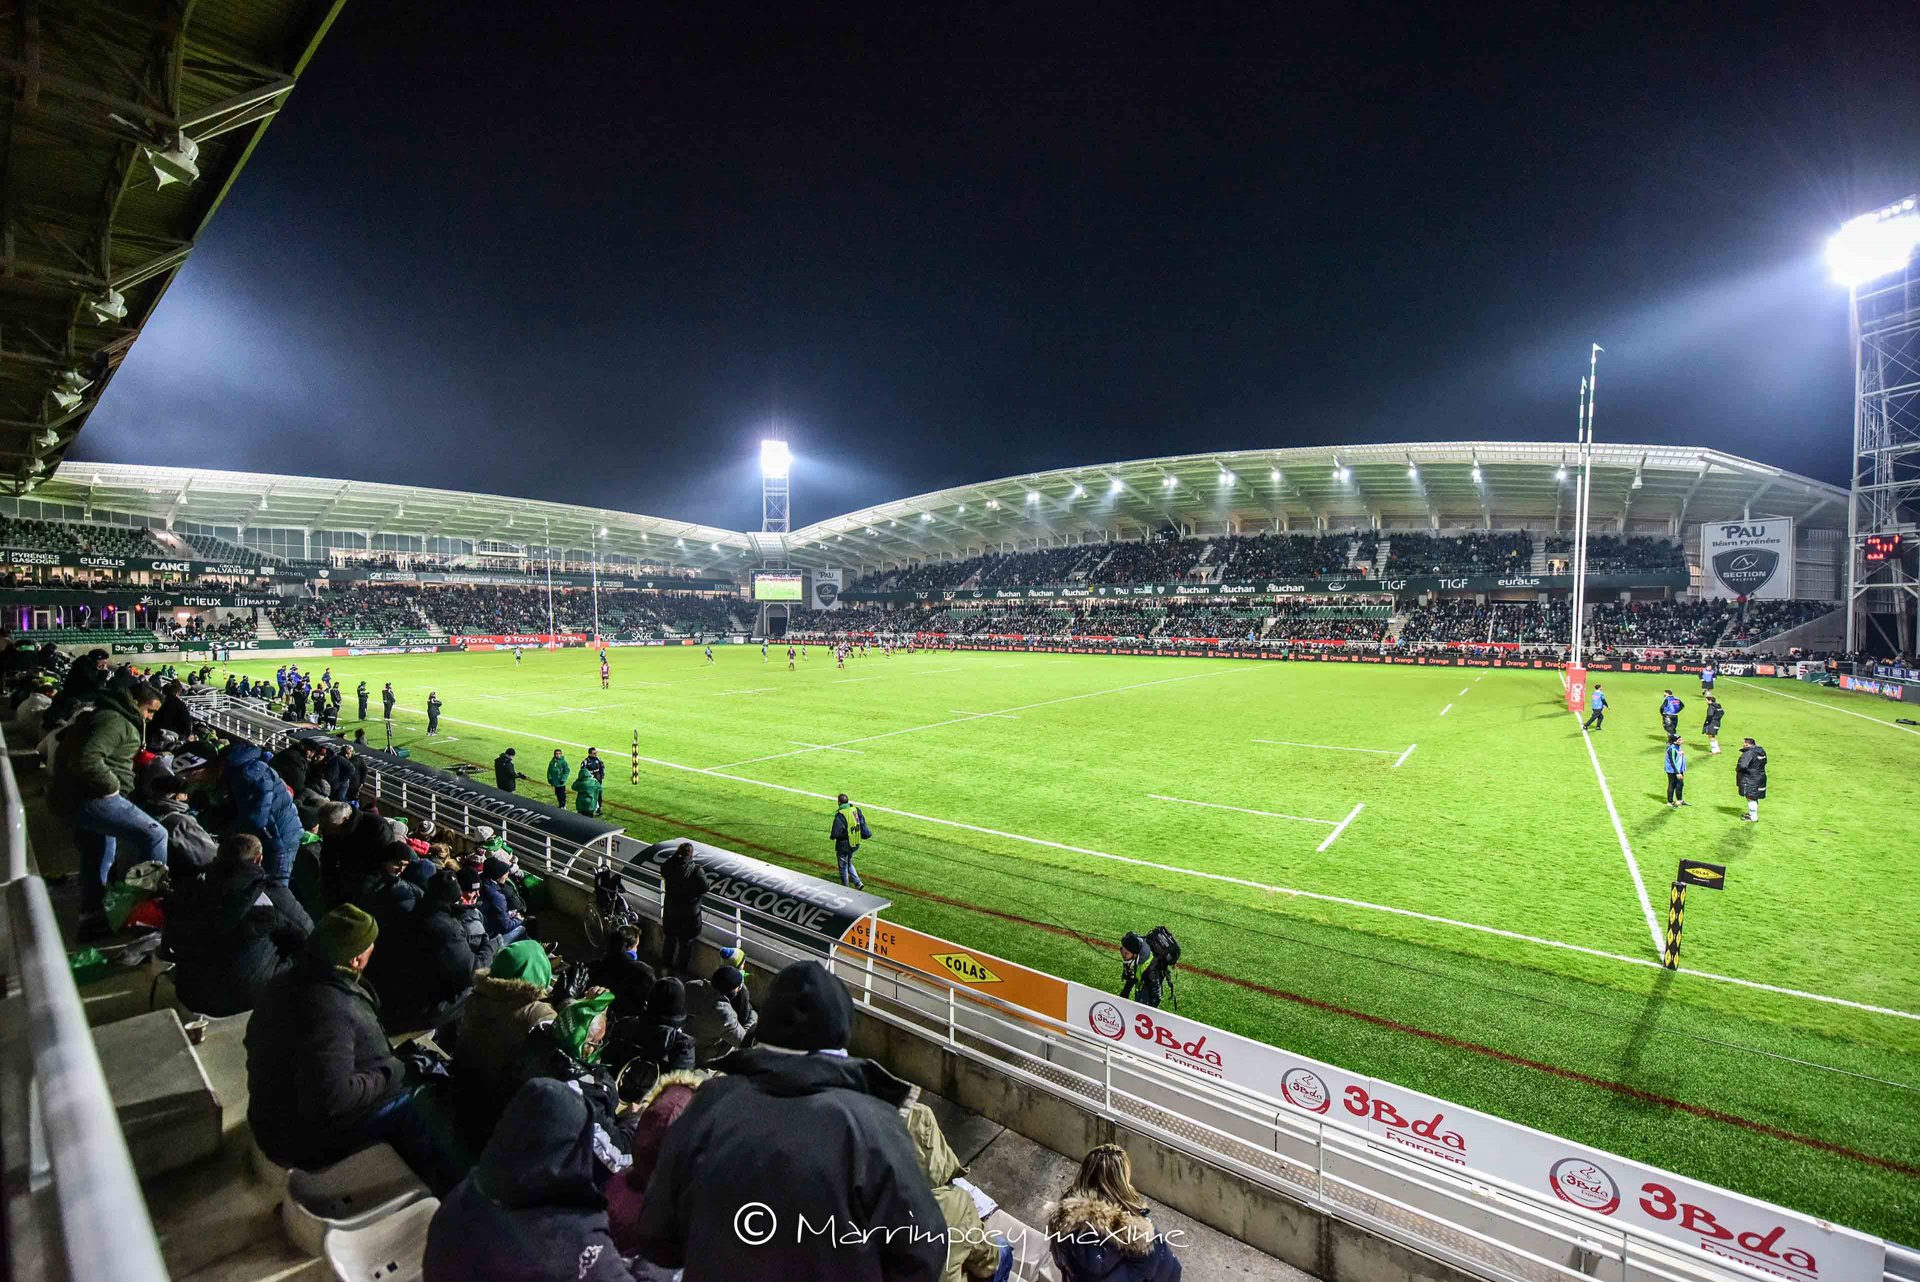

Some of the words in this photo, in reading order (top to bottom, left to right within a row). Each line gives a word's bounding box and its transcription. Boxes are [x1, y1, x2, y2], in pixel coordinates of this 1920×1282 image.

[1720, 525, 1766, 539] PAU
[1740, 537, 1781, 546] Pyrénées
[11, 557, 60, 565] GASCOGNE
[209, 566, 251, 575] ALVAREZ
[1266, 583, 1305, 592] Auchan
[1379, 580, 1407, 590] TIGF
[1438, 578, 1469, 589] TIGF
[1028, 589, 1058, 597] Auchan
[1062, 588, 1089, 597] Auchan
[1176, 585, 1209, 594] Auchan
[1219, 584, 1255, 593] Auchan
[409, 637, 448, 645] SCOPELEC
[600, 633, 617, 641] AGEC
[1395, 657, 1414, 665] Orange
[1429, 658, 1450, 666] Orange
[1467, 659, 1490, 667] Orange
[1505, 660, 1529, 669] Orange
[1587, 663, 1613, 672] Orange
[1634, 663, 1662, 673] Orange
[704, 872, 834, 931] GASCOGNE
[945, 956, 987, 980] COLAS
[1134, 1013, 1223, 1067] 3Bda
[1343, 1085, 1467, 1151] 3Bda
[1566, 1174, 1609, 1197] 3Bda
[1639, 1182, 1819, 1274] 3Bda
